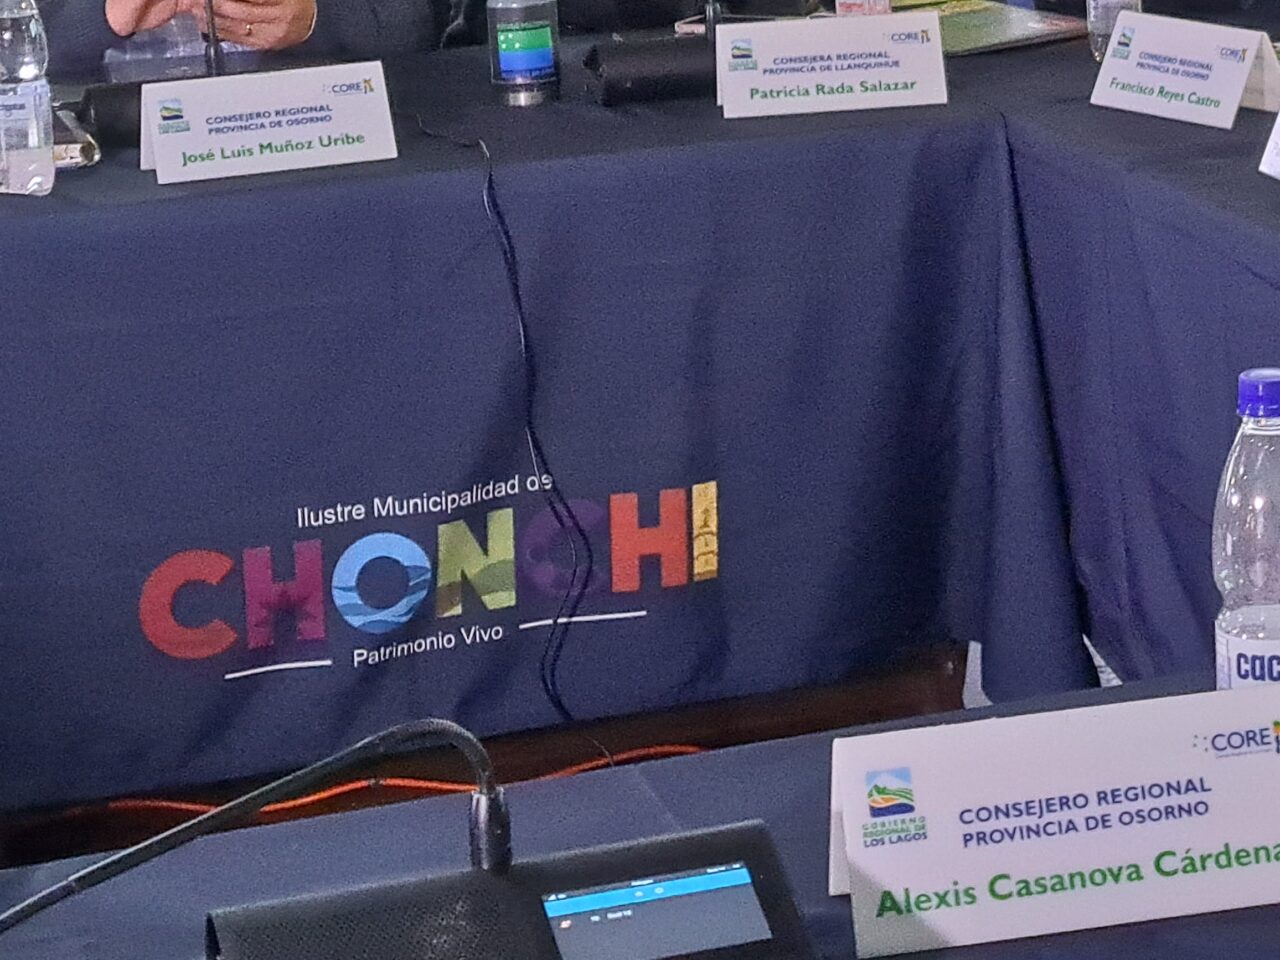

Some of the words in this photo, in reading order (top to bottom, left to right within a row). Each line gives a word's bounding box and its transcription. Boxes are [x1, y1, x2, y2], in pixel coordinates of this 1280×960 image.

[891, 32, 919, 42] CORE
[763, 64, 816, 75] PROVINCIA
[820, 63, 832, 72] DE
[835, 59, 900, 71] LLANQUIHUE
[773, 53, 833, 66] CONSEJERA
[836, 50, 890, 62] REGIONAL
[1138, 51, 1178, 65] CONSEJERO
[1179, 57, 1213, 72] REGIONAL
[1136, 62, 1169, 74] PROVINCIA
[1181, 68, 1210, 81] OSORNO
[331, 81, 362, 94] CORE
[750, 84, 810, 100] Patricia
[816, 82, 854, 95] Rada
[860, 79, 917, 93] Salazar
[1109, 77, 1154, 96] Francisco
[1157, 85, 1185, 102] Reyes
[1187, 92, 1221, 108] Castro
[205, 108, 271, 125] CONSEJERO
[274, 103, 333, 119] REGIONAL
[208, 119, 266, 135] PROVINCIA
[269, 118, 283, 129] DE
[286, 114, 332, 127] OSORNO
[181, 148, 216, 167] José
[220, 146, 254, 160] Luis
[258, 138, 313, 156] Muñoz
[319, 132, 365, 148] Uribe
[297, 503, 365, 529] Ilustre
[374, 474, 519, 519] Municipalidad
[138, 480, 718, 660] CHONCHI
[353, 630, 455, 667] Patrimonio
[460, 623, 504, 644] Vivo
[1211, 728, 1272, 752] CORE
[958, 792, 1090, 827] CONSEJERO
[1096, 777, 1213, 806] REGIONAL
[962, 820, 1080, 849] PROVINCIA
[1084, 814, 1113, 831] DE
[1118, 800, 1210, 826] OSORNO
[864, 837, 885, 848] LOS
[889, 832, 928, 844] LAGOS
[875, 880, 978, 919] Alexis
[987, 860, 1145, 902] Casanova
